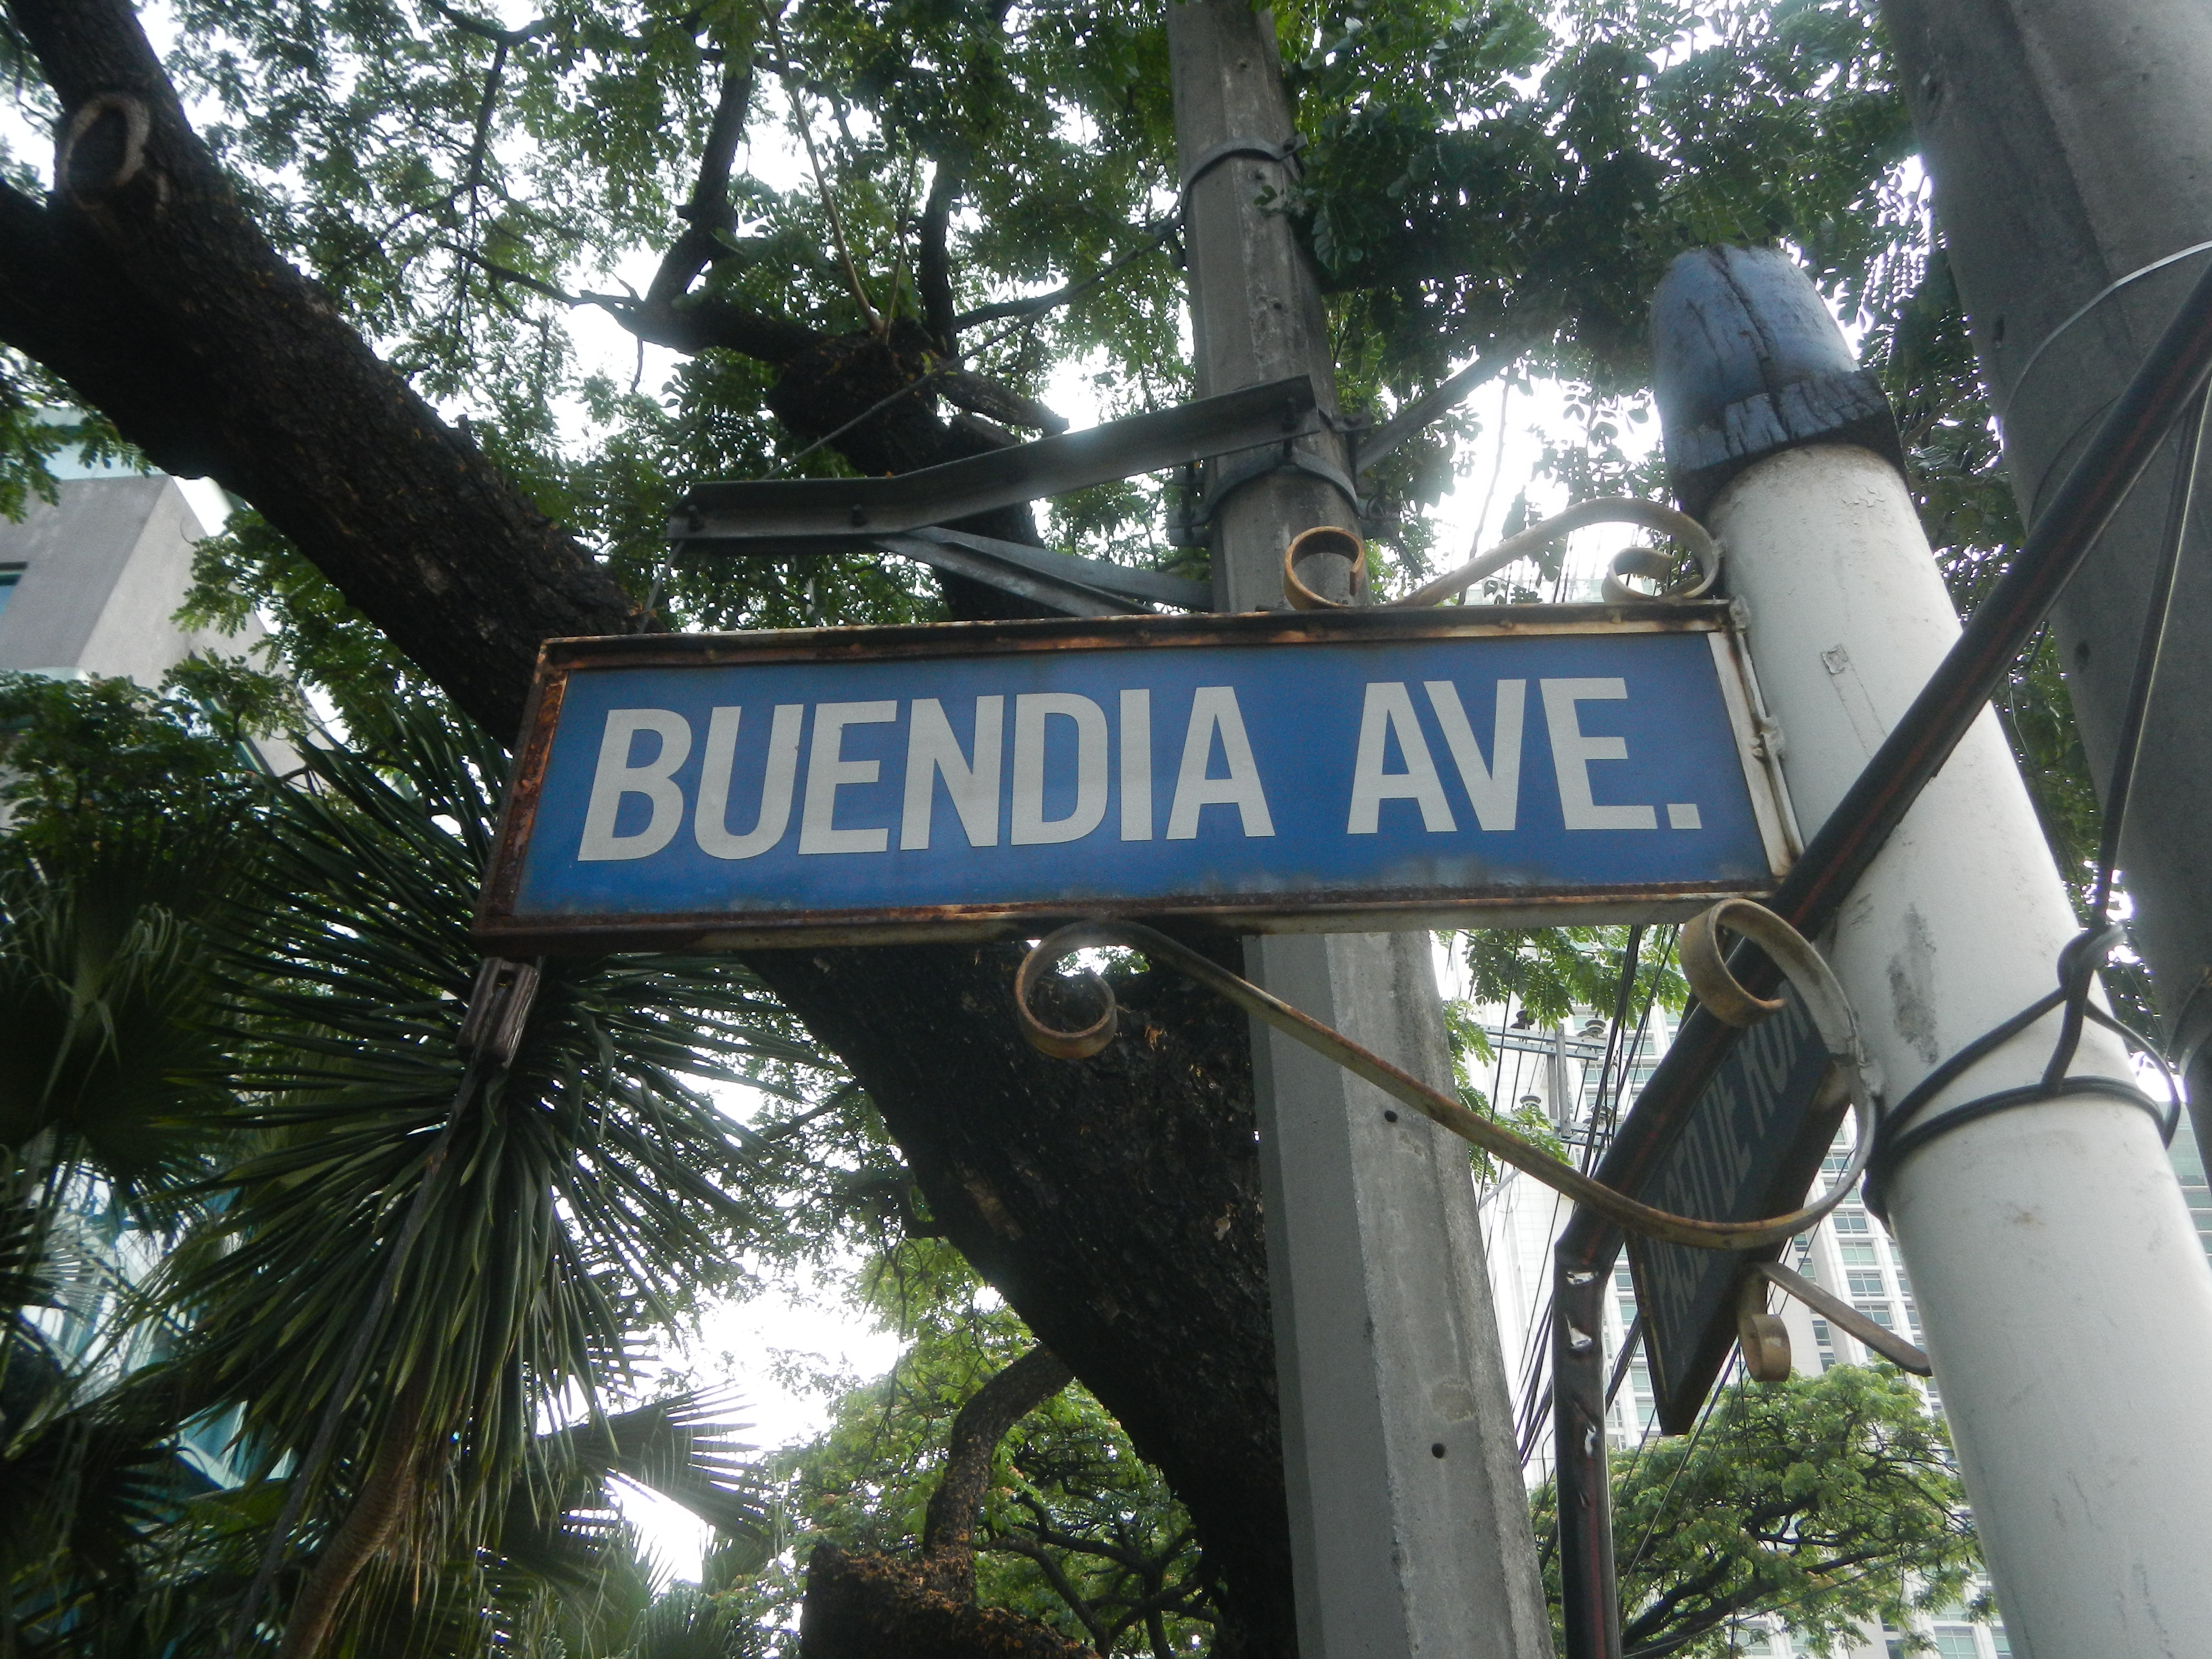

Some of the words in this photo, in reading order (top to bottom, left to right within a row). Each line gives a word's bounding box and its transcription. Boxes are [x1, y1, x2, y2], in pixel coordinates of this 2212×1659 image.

[577, 685, 1275, 861] BUENDIA
[1347, 677, 1702, 834] AVE.
[1700, 1070, 1752, 1216] DE
